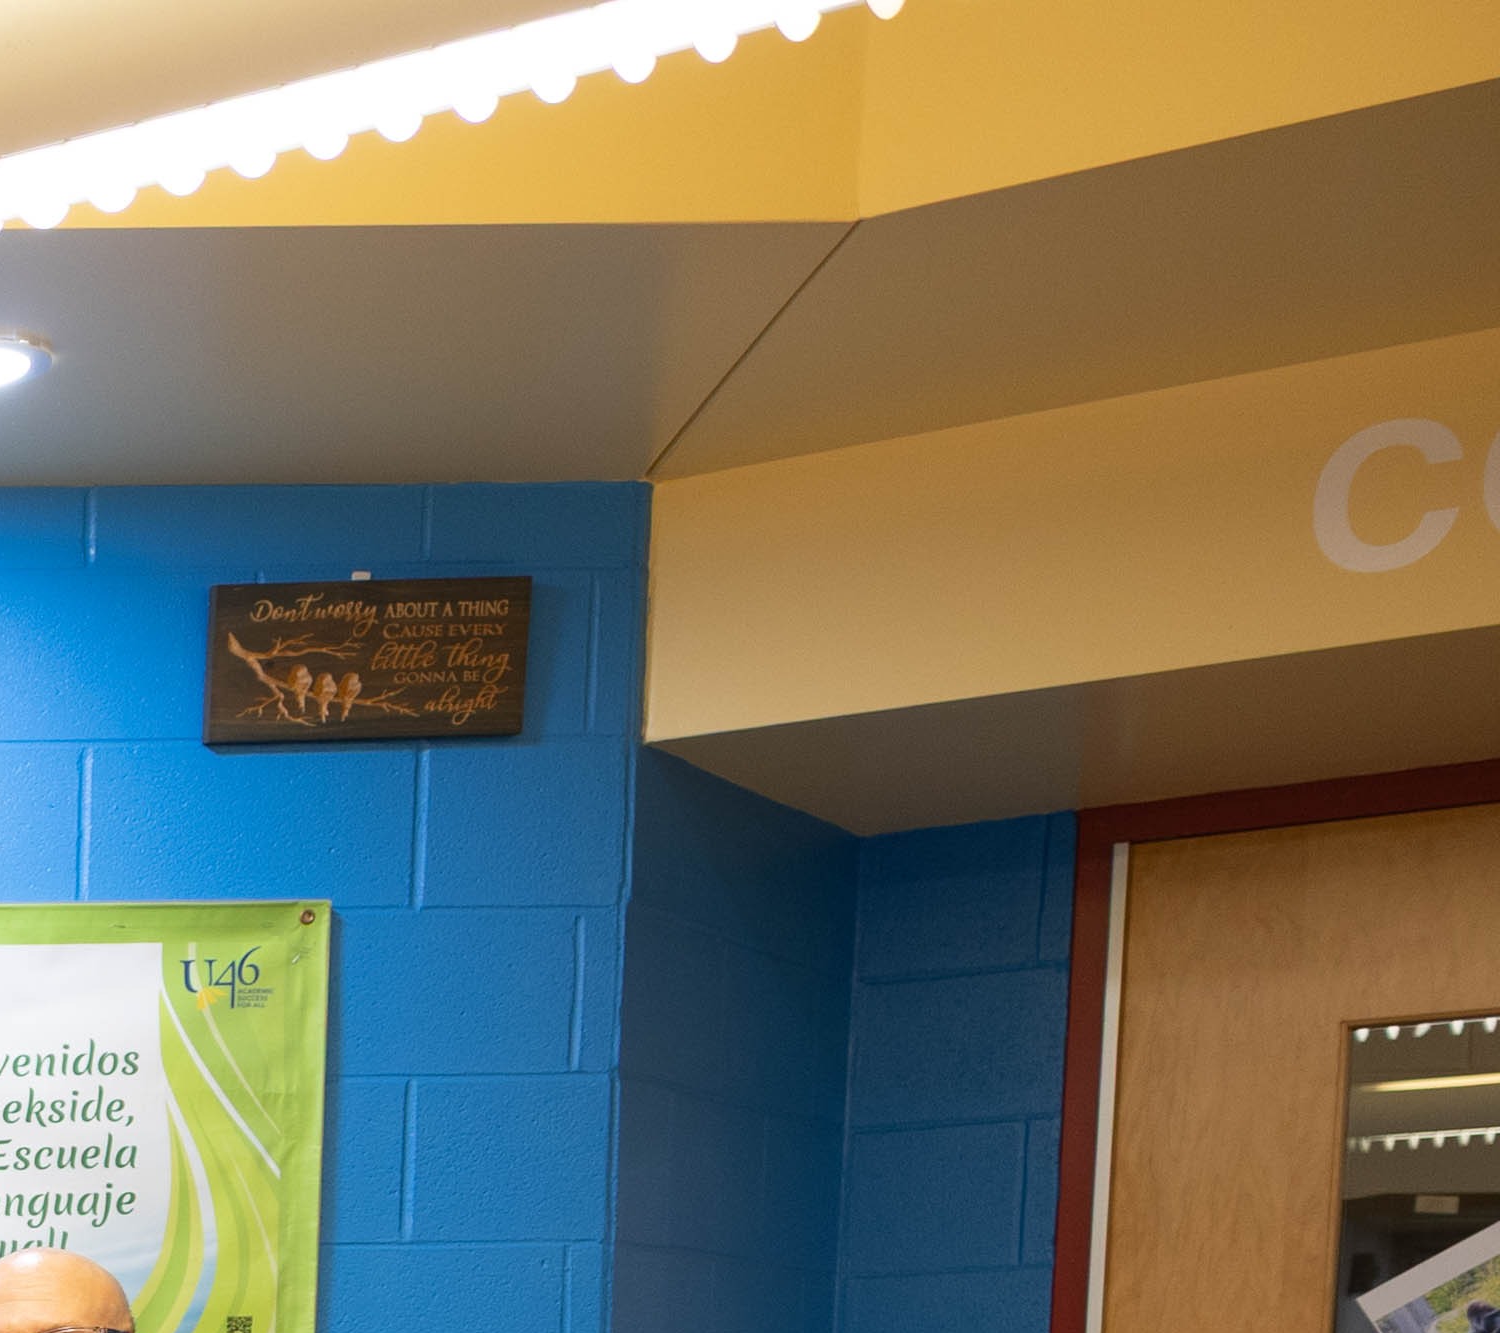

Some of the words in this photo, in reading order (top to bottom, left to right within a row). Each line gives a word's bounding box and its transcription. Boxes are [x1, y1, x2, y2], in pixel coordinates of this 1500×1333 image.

[1312, 417, 1500, 573] C
[385, 602, 438, 618] ABOUT
[443, 602, 453, 617] A
[458, 599, 509, 617] THING
[383, 623, 443, 640] CAUSE
[450, 623, 507, 638] EVERY
[371, 640, 436, 671] little
[446, 638, 512, 685] thing
[394, 671, 458, 685] GONNA
[464, 671, 481, 683] BE
[180, 945, 262, 1009] U46
